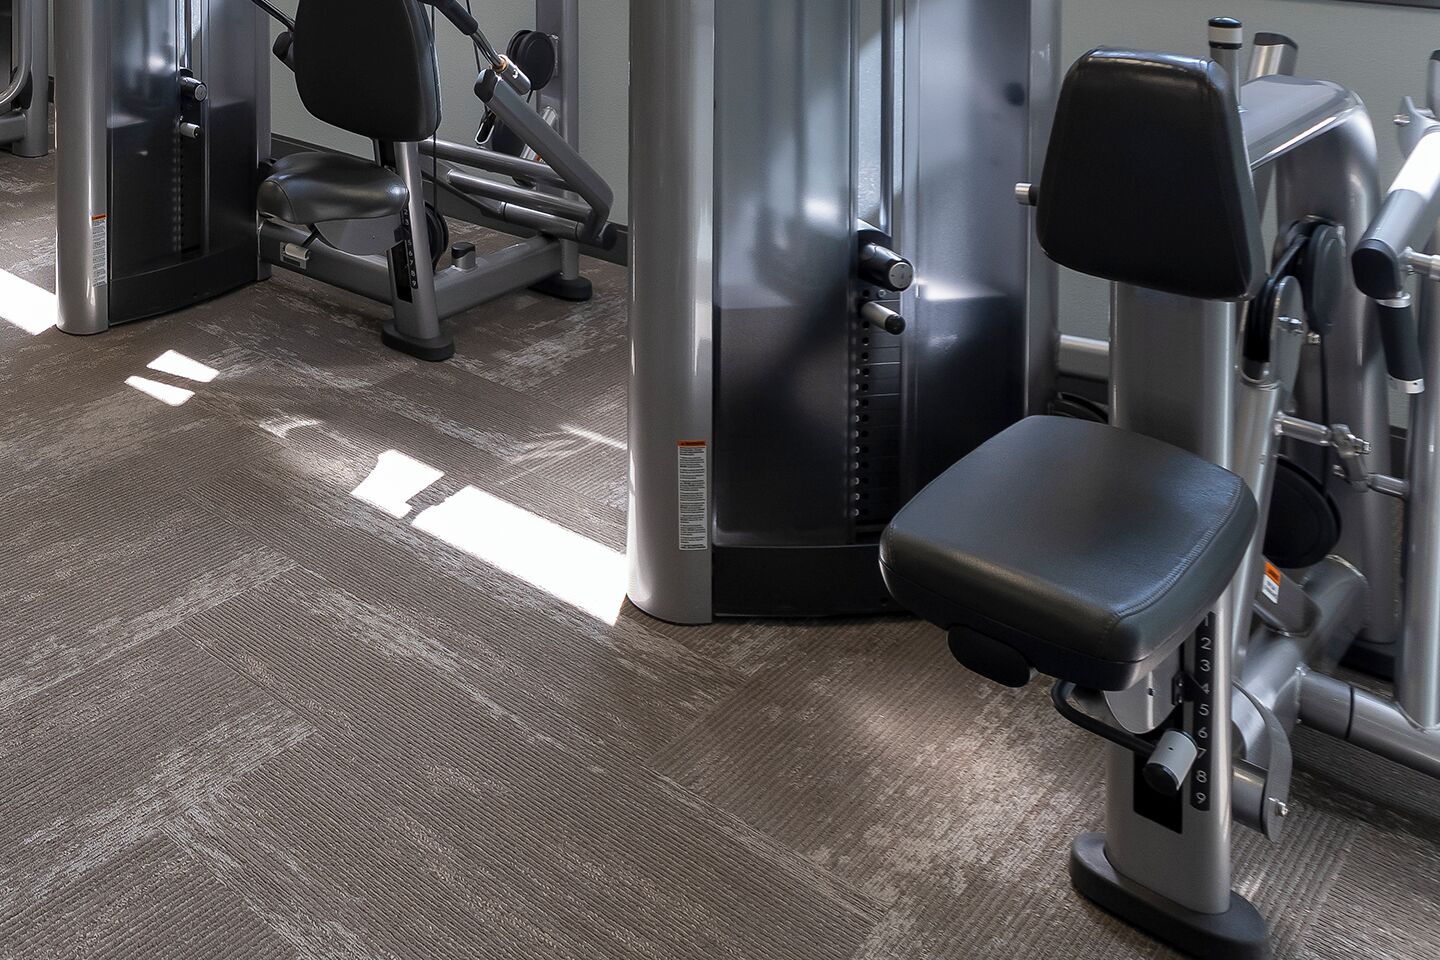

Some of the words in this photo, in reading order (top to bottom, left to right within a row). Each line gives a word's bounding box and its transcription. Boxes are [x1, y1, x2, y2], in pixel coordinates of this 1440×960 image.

[1200, 637, 1212, 650] 2
[1200, 659, 1211, 672] 3
[1200, 682, 1210, 695] 4
[1198, 703, 1210, 716] 5
[1198, 726, 1208, 739] 6
[1197, 746, 1207, 759] 7
[1196, 769, 1208, 783] 8
[1195, 792, 1207, 804] 9
